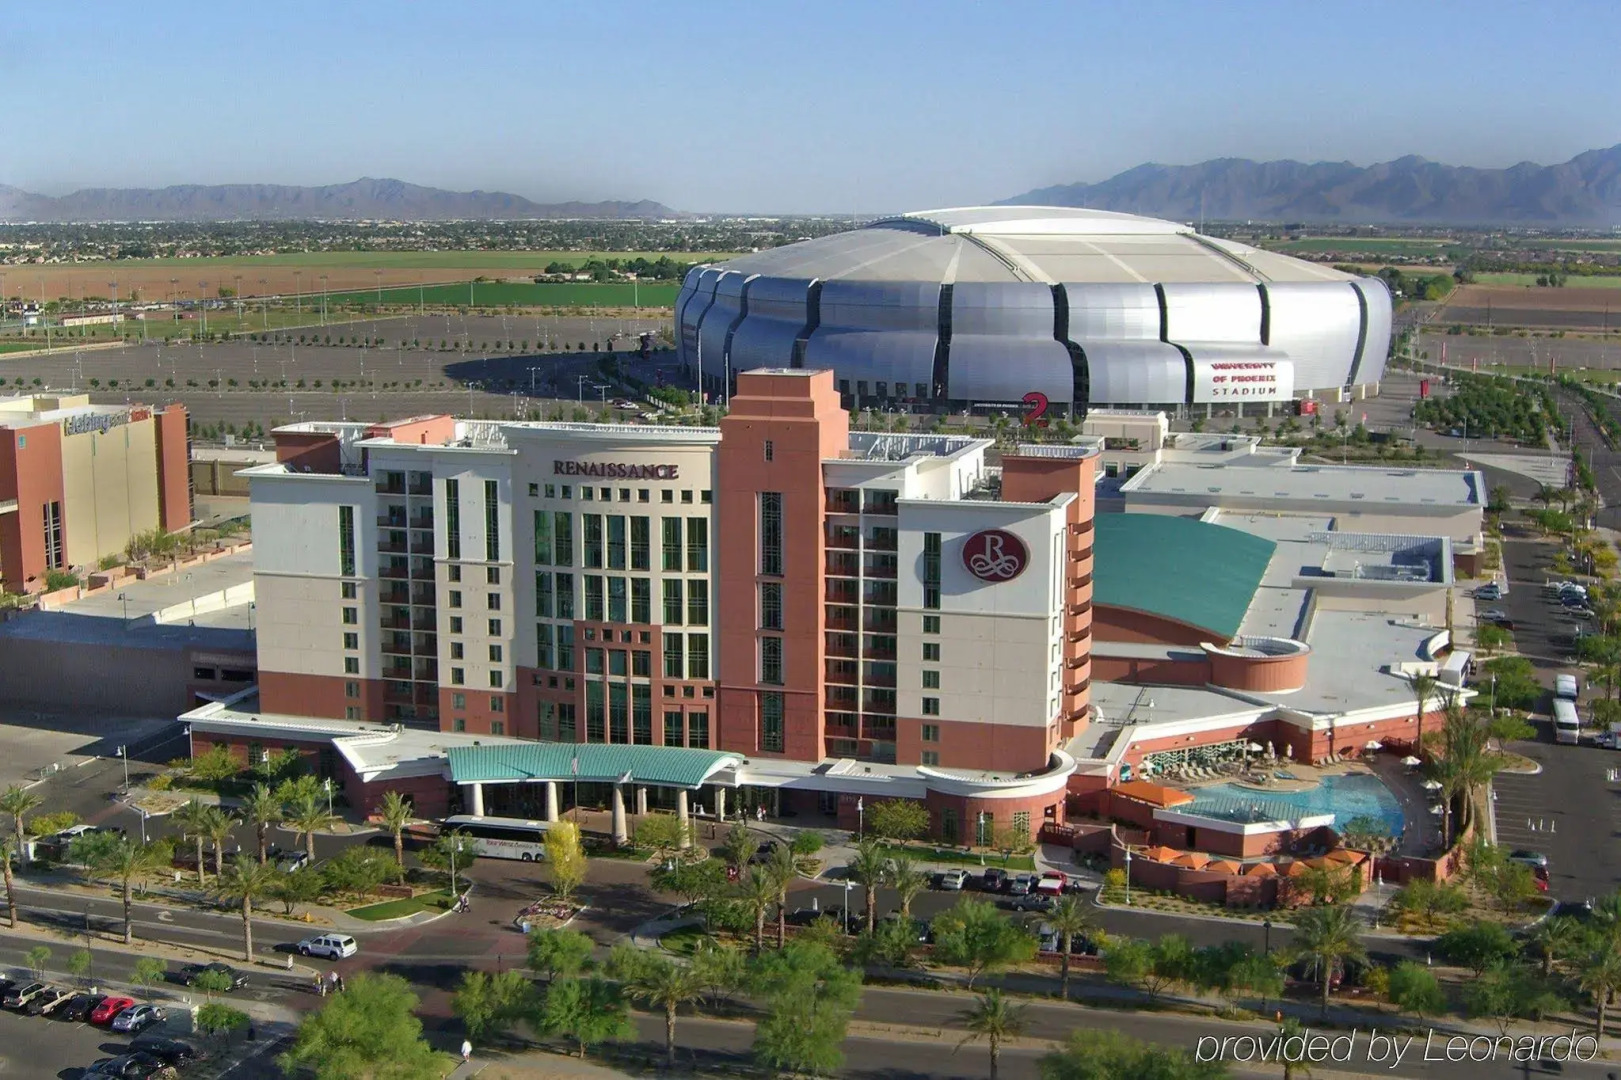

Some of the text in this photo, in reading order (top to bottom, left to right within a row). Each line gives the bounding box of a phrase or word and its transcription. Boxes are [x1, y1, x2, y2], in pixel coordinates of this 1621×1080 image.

[1213, 375, 1228, 383] OF
[1212, 387, 1277, 396] STADIUM
[1022, 391, 1049, 428] 2
[554, 460, 679, 480] RENAISSANCE
